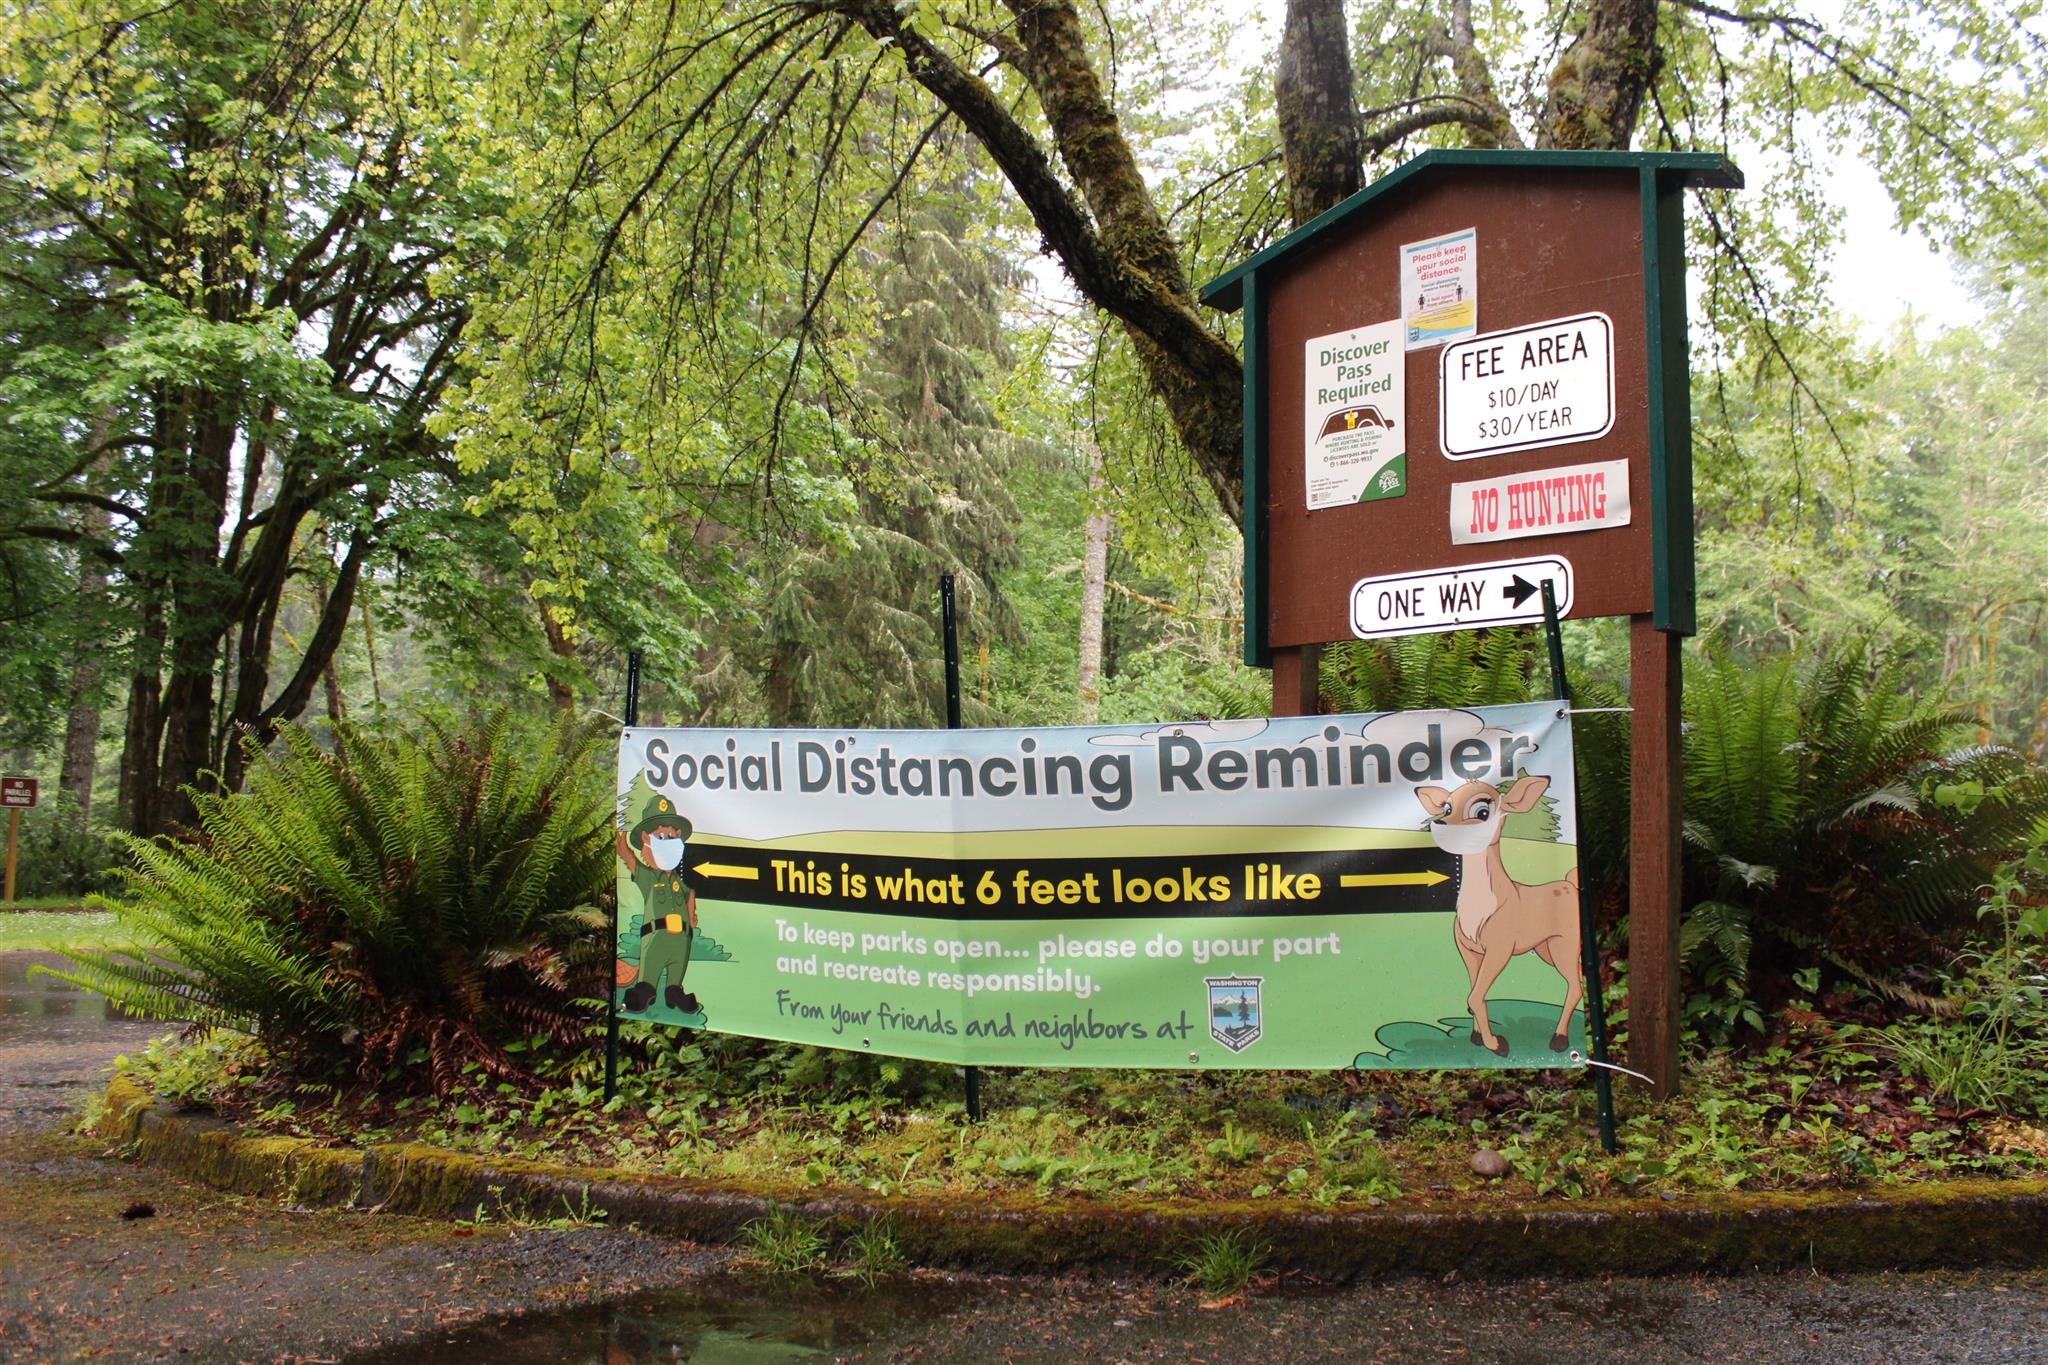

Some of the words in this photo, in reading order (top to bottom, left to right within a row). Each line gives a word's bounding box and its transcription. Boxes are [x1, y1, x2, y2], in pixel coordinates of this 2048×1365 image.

[1412, 251, 1442, 263] Please
[1444, 245, 1466, 256] keep
[1416, 261, 1437, 274] your
[1439, 253, 1467, 266] social
[1420, 265, 1462, 281] distance.
[1320, 340, 1390, 367] Discover
[1462, 346, 1504, 380] FEE
[1521, 331, 1588, 370] AREA
[1318, 373, 1391, 405] Required
[1337, 363, 1372, 382] Pass
[1488, 379, 1560, 408] $10/DAY
[1478, 406, 1572, 439] $30/YEAR
[1470, 487, 1499, 534] NO
[1507, 471, 1607, 530] HUNTING
[1378, 587, 1425, 621] ONE
[1439, 580, 1486, 614] WAY
[645, 738, 782, 792] Social
[798, 736, 1133, 811] Distancing
[1159, 723, 1530, 792] Reminder
[771, 860, 831, 896] This
[842, 864, 866, 898] is
[875, 868, 965, 905] what
[976, 871, 1001, 905] 6
[1012, 872, 1100, 905] feet
[1112, 867, 1231, 903] looks
[1244, 864, 1322, 900] like
[775, 919, 798, 943] To
[803, 921, 856, 954] keep
[861, 928, 927, 956] parks
[934, 937, 1030, 963] open...
[1039, 934, 1136, 964] please
[1145, 934, 1184, 958] do
[1192, 937, 1264, 964] your
[1273, 932, 1340, 962] part
[776, 954, 817, 978] and
[823, 960, 921, 987] recreate
[927, 967, 1101, 999] responsibly.
[776, 990, 825, 1021] From
[831, 1003, 871, 1035] your
[877, 1003, 958, 1037] friends
[965, 1012, 1015, 1039] and
[1024, 1008, 1148, 1050] neighbors
[1150, 1009, 1195, 1040] at
[1212, 1029, 1236, 1048] STATE
[1236, 1028, 1260, 1048] PARKS
